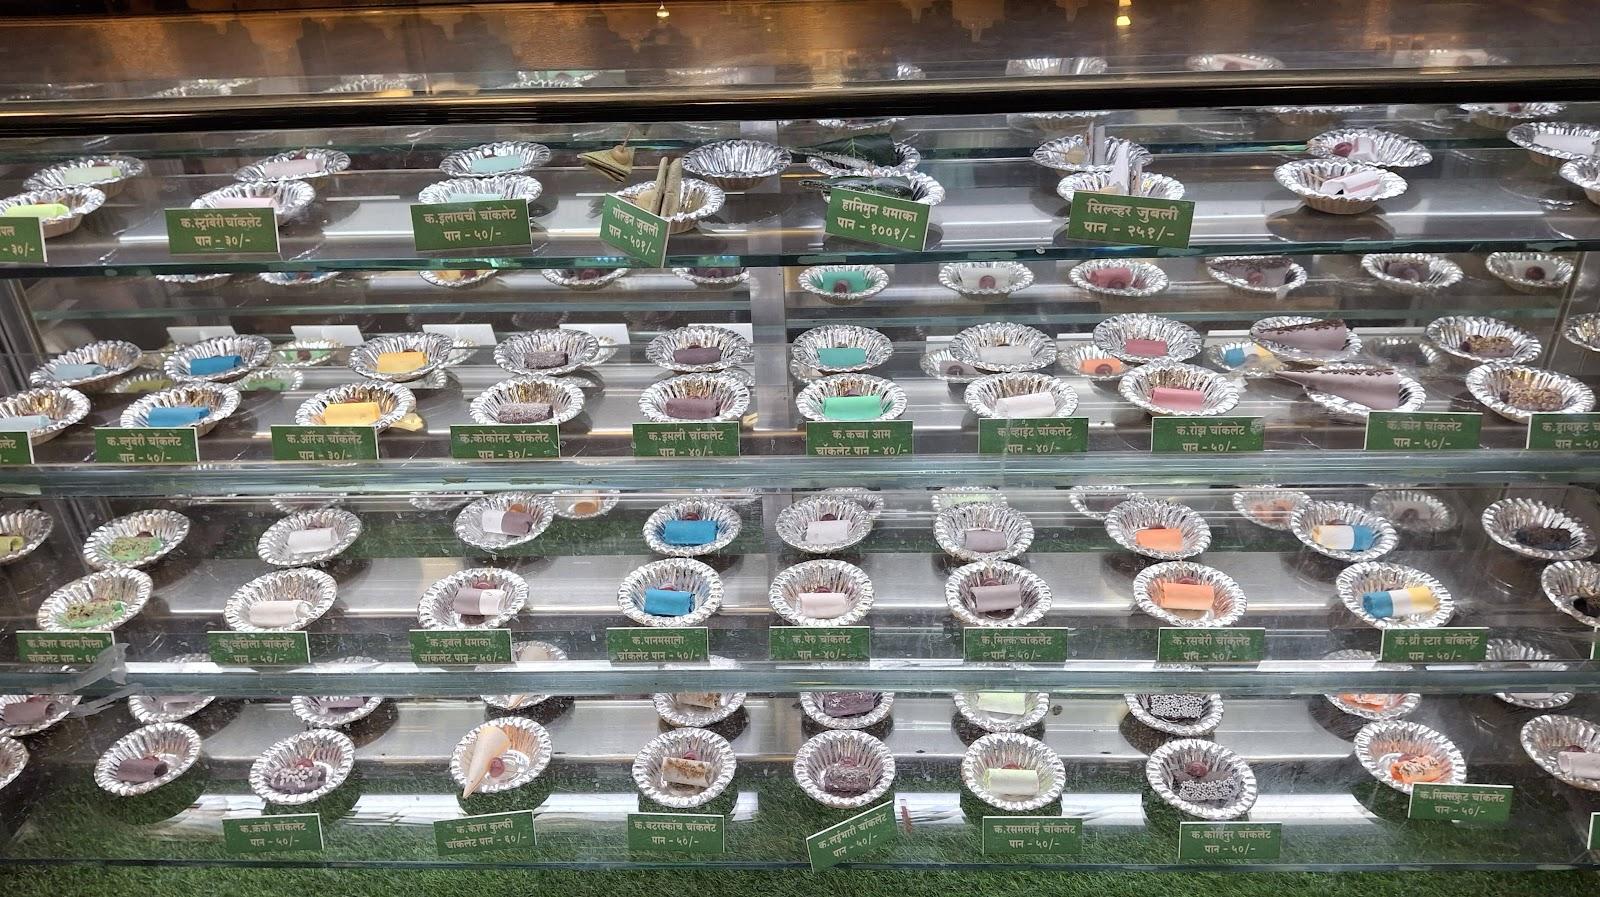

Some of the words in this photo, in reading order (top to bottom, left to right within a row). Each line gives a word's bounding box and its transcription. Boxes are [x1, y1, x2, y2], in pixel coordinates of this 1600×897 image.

[842, 197, 878, 219] हानिमुन
[882, 206, 918, 223] धमाका
[1087, 198, 1133, 218] सिल्व्हर
[1136, 205, 1180, 224] जुबली
[612, 203, 635, 226] गोल्डन
[636, 217, 659, 238] जुबली
[443, 230, 461, 241] पान
[474, 226, 501, 241] ५०/-
[837, 217, 856, 230] पान
[870, 223, 916, 242] १००१/-
[1084, 221, 1107, 234] पान
[1127, 225, 1175, 241] २५१/-
[194, 235, 212, 246] पान
[224, 233, 251, 248] ३०/-
[609, 223, 622, 239] पान
[630, 235, 656, 256] ५०१/-
[11, 241, 35, 257] ३०/-
[871, 429, 891, 440] आम
[1007, 444, 1023, 454] पान
[1035, 442, 1061, 454] ४०/-
[1182, 442, 1198, 452] पान
[1211, 441, 1237, 452] ५०/-
[1392, 437, 1411, 447] पान
[1424, 437, 1451, 449] ५०/-
[1554, 439, 1572, 449] पान
[298, 451, 314, 460] पान
[327, 449, 352, 460] ३०/-
[478, 450, 494, 459] पान
[507, 448, 533, 460] ३०/-
[659, 448, 675, 457] पान
[688, 446, 713, 457] ४०/-
[853, 446, 870, 456] पान
[882, 444, 908, 456] ४०/-
[119, 453, 135, 463] पान
[147, 451, 172, 463] ५०/-
[261, 636, 295, 650] चॉकलेट
[464, 638, 491, 647] धमाका
[818, 631, 851, 644] चॉकलेट
[1422, 636, 1441, 645] स्टार
[27, 651, 60, 663] चॉकलेट
[60, 654, 74, 663] पान
[233, 654, 248, 663] पान
[260, 653, 284, 663] ५०/-
[420, 651, 452, 663] चॉकलेट
[453, 653, 469, 663] पान
[480, 652, 503, 663] ५०/-
[651, 651, 666, 661] पान
[677, 649, 700, 660] ५०/-
[797, 650, 812, 660] पान
[823, 648, 846, 660] ४०/-
[991, 651, 1006, 660] पान
[1018, 649, 1041, 660] ५०/-
[1183, 651, 1199, 661] पान
[1212, 651, 1237, 661] ५०/-
[1408, 651, 1424, 660] पान
[1436, 650, 1462, 661] ५०/-
[1434, 805, 1450, 814] पान
[1461, 805, 1486, 817] ५०/-
[489, 818, 513, 834] कुल्फी
[857, 813, 888, 830] चॉकलेट
[249, 838, 265, 847] पान
[275, 835, 300, 847] ५०/-
[479, 837, 493, 846] पान
[651, 836, 666, 845] पान
[676, 836, 699, 848] ५०/-
[832, 846, 847, 857] पान
[856, 832, 878, 847] ५०/-
[1008, 839, 1024, 848] पान
[1035, 838, 1060, 850] ५०/-
[1204, 845, 1219, 853] पान
[1231, 843, 1256, 855] ५०/-
